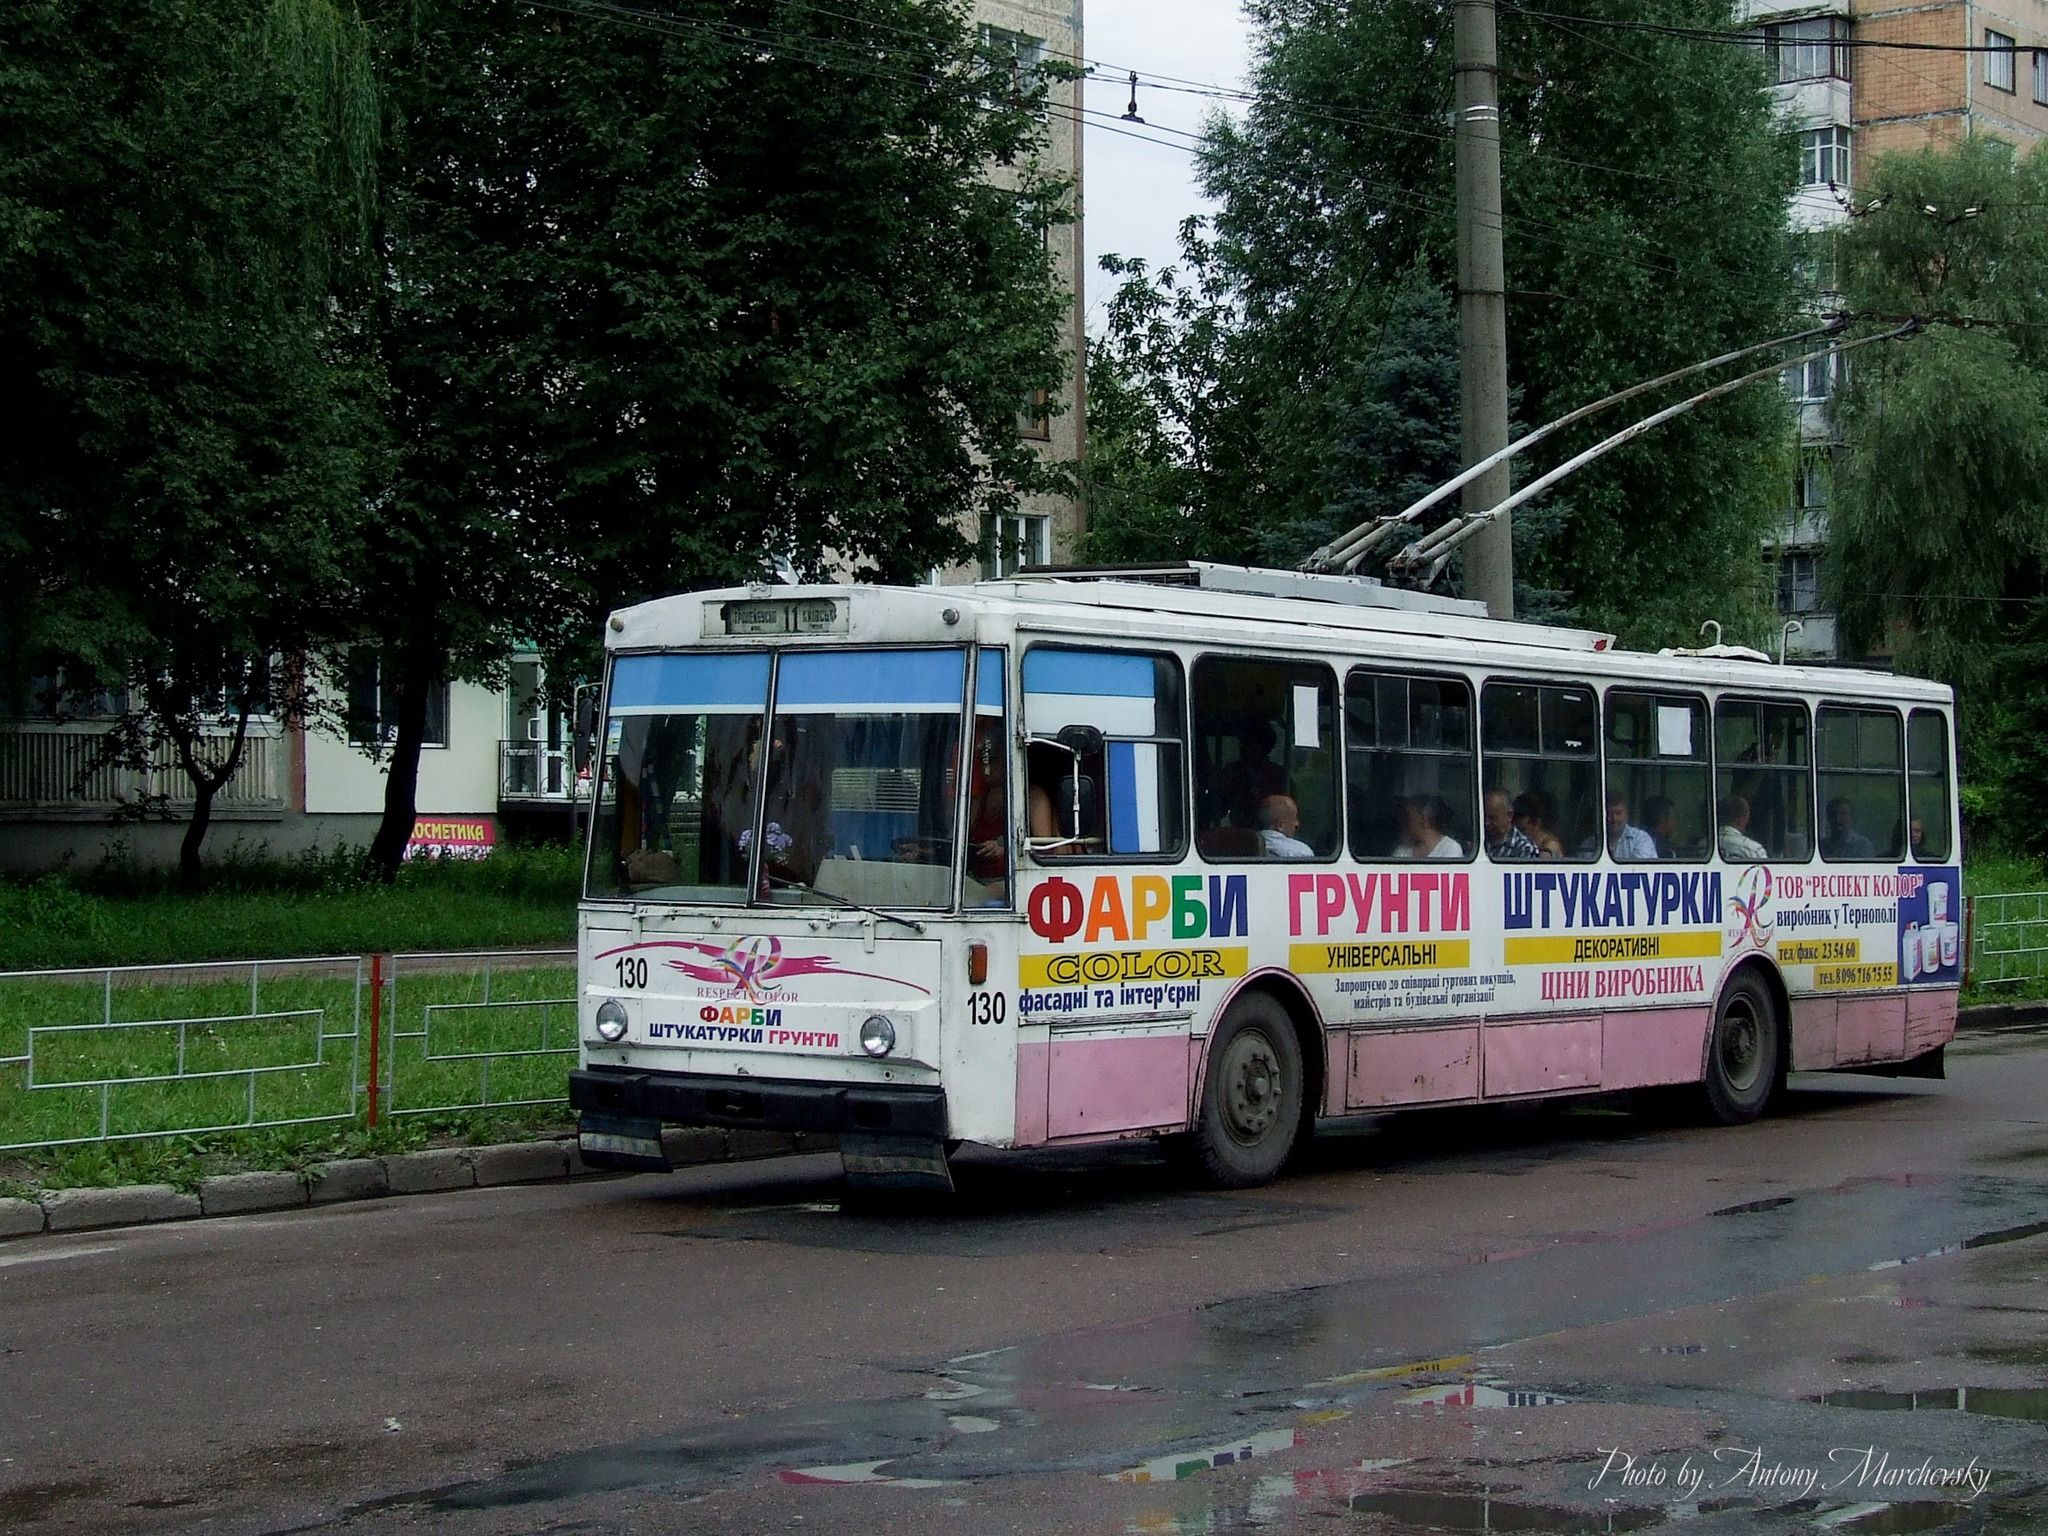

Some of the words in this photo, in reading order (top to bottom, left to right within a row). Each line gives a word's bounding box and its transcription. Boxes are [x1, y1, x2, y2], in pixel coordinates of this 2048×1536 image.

[1504, 872, 1722, 929] ШТУКАТУРКИ
[1776, 876, 1804, 899] ТОВ
[1028, 875, 1248, 943] ФАРБИ
[1288, 873, 1470, 936] ГРУНТИ
[1776, 902, 1831, 931] виробник
[1833, 908, 1840, 929] у
[1842, 902, 1897, 929] Тернополі
[1327, 944, 1437, 969] УНІВЕРСАЛЬНІ
[1574, 937, 1660, 963] ДЕКОРАТИВНІ
[615, 956, 648, 990] 130
[1047, 950, 1225, 984] COLOR
[1334, 977, 1388, 995] Запрошуємо
[1389, 979, 1399, 992] до
[1401, 973, 1440, 993] співпраці
[1541, 971, 1589, 1002] ЦІНИ
[1595, 964, 1704, 998] ВИРОБНИКА
[967, 991, 1006, 1025] 130
[1018, 985, 1088, 1014] фасадні
[1094, 988, 1114, 1008] та
[1353, 994, 1391, 1011] майстрів
[1393, 996, 1403, 1007] та
[1405, 991, 1449, 1010] будівельні
[1451, 988, 1495, 1007] організації
[699, 1005, 782, 1027] ФАРБИ
[649, 1022, 762, 1044] ШТУКАТУРКИ
[768, 1029, 839, 1048] ГРУНТИ
